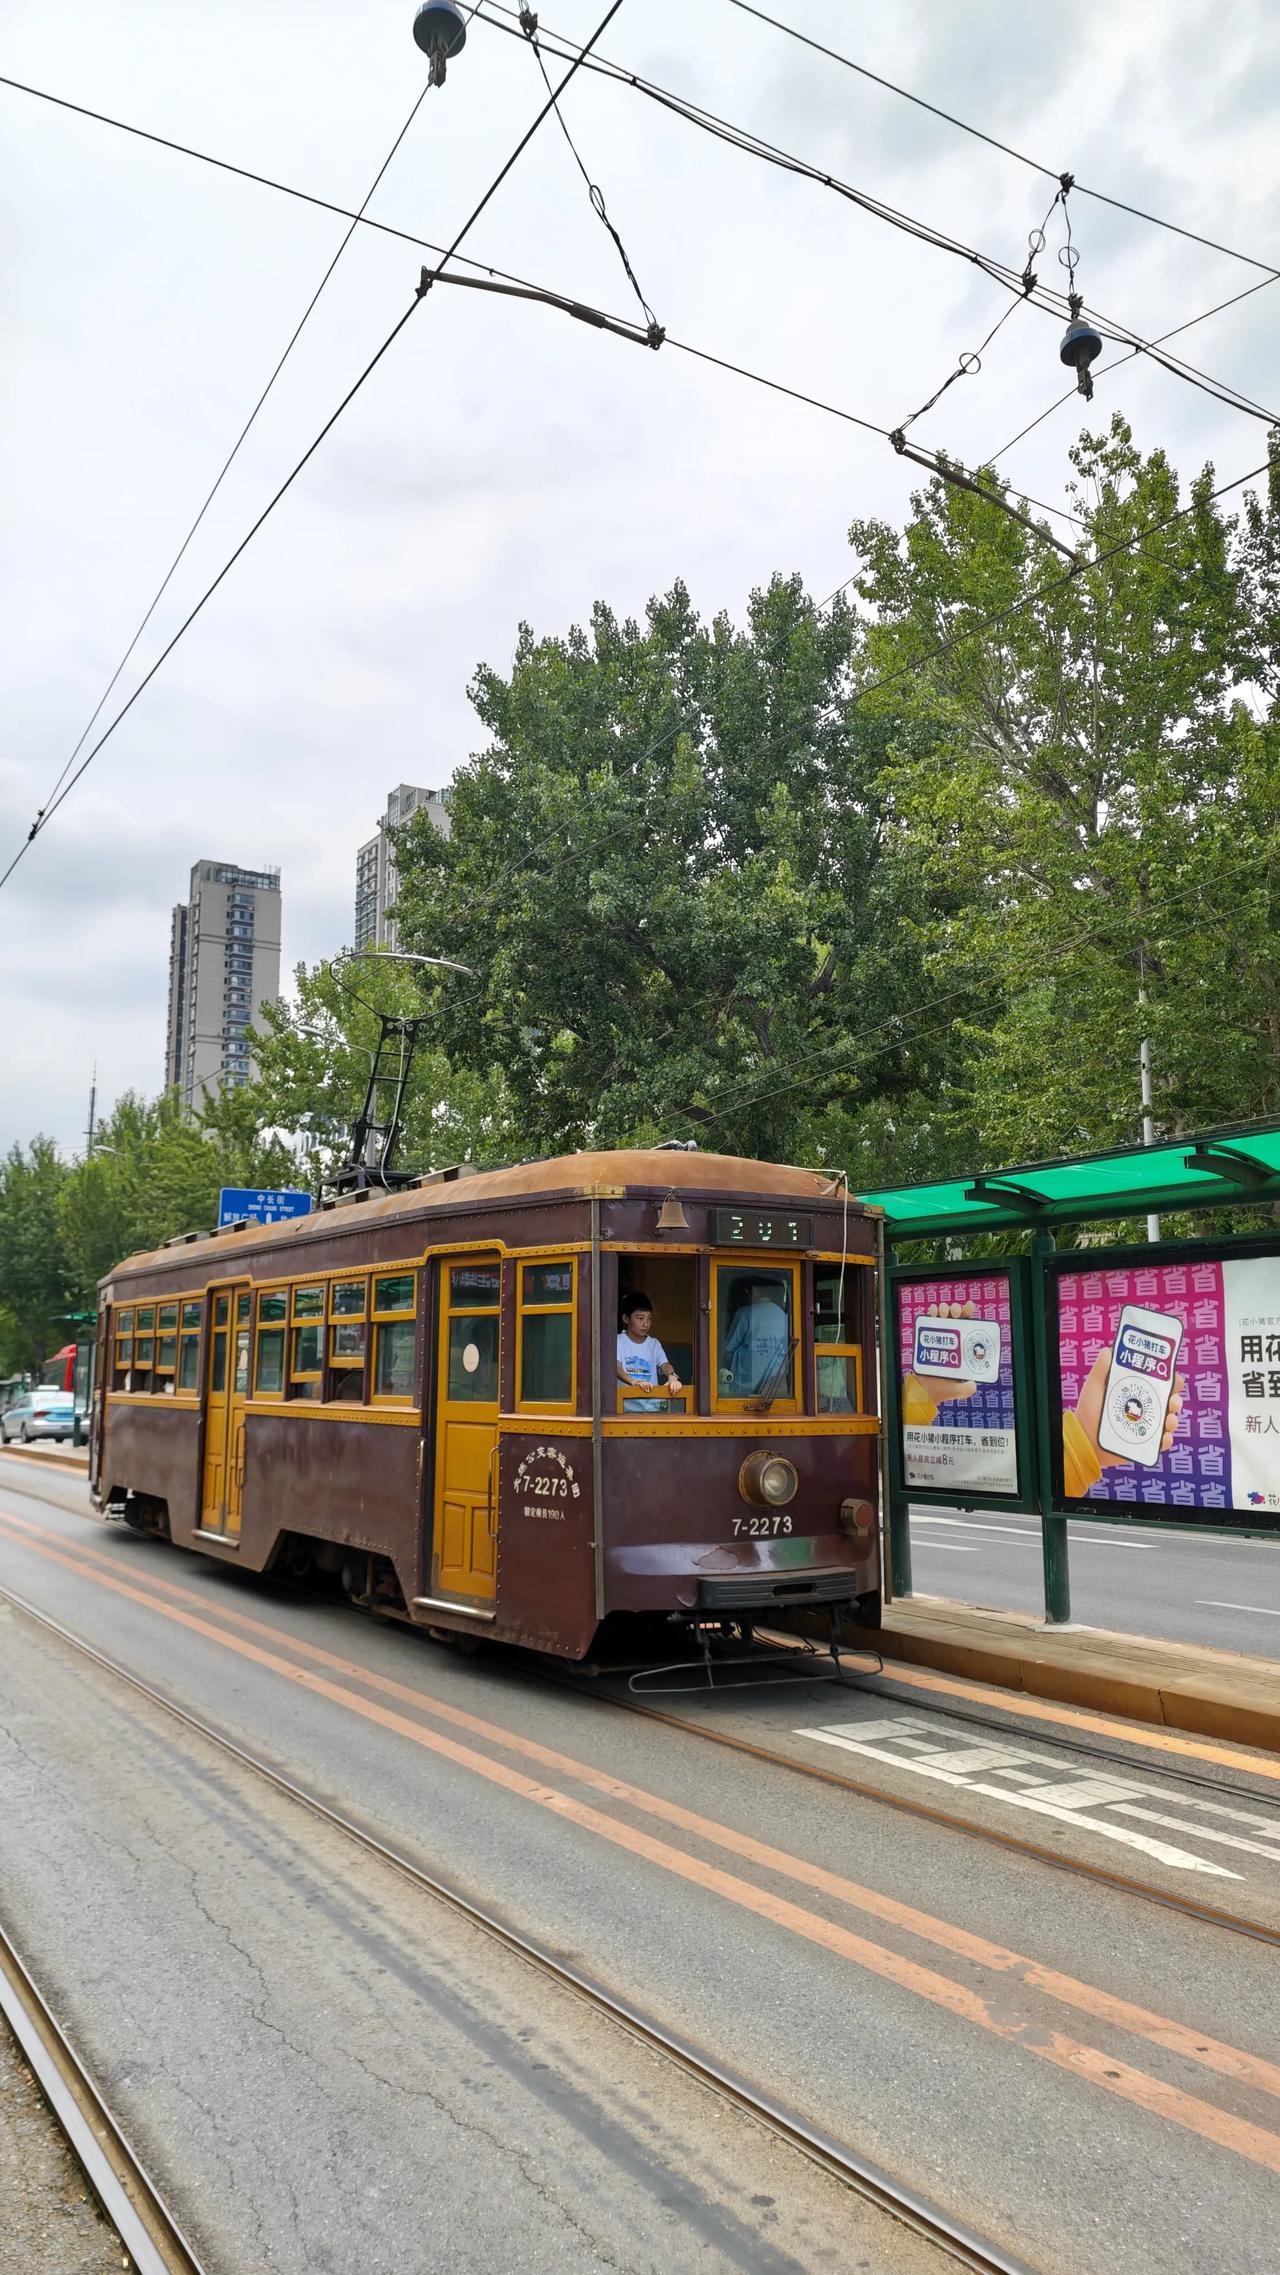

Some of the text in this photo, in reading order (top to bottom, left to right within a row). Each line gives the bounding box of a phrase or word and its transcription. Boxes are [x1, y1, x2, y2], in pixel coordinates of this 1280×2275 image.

[257, 1194, 285, 1205] 中长街
[923, 1334, 956, 1346] 花小猪打车
[1128, 1334, 1168, 1355] 花小猪打车
[920, 1348, 950, 1364] 小程序
[1120, 1349, 1157, 1373] 小程序
[1245, 1414, 1280, 1434] 新人
[523, 1474, 568, 1497] 7-2273
[731, 1515, 793, 1536] 7-2273
